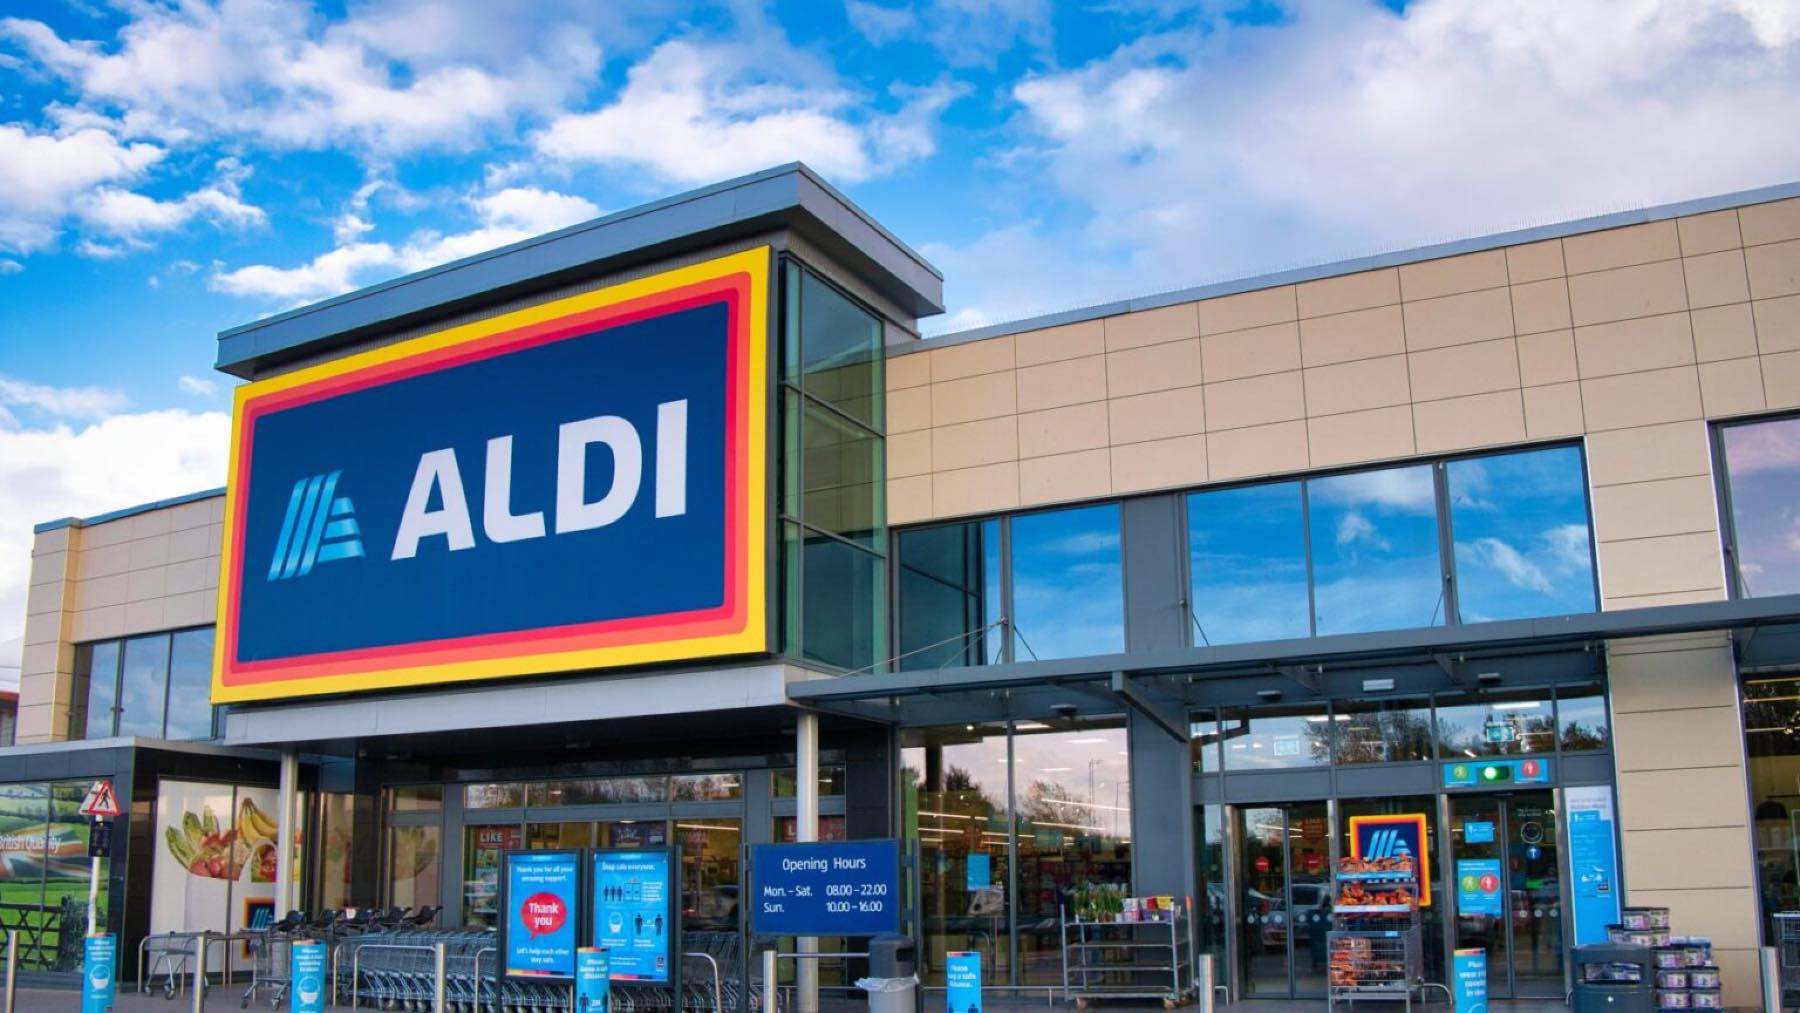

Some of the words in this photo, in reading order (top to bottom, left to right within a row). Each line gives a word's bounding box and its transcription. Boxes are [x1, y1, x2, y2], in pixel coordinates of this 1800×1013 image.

[390, 398, 688, 561] ALDI
[480, 831, 504, 842] LIKE
[782, 857, 828, 873] Opening
[833, 857, 866, 869] Hours
[763, 886, 787, 897] Mon.
[795, 885, 813, 897] Sat.
[825, 884, 852, 896] 08.00
[861, 883, 887, 896] 22.00
[529, 902, 559, 914] Thank
[763, 902, 785, 913] Sun.
[826, 901, 850, 912] 10.00
[859, 901, 883, 912] 16.00
[534, 917, 553, 928] you
